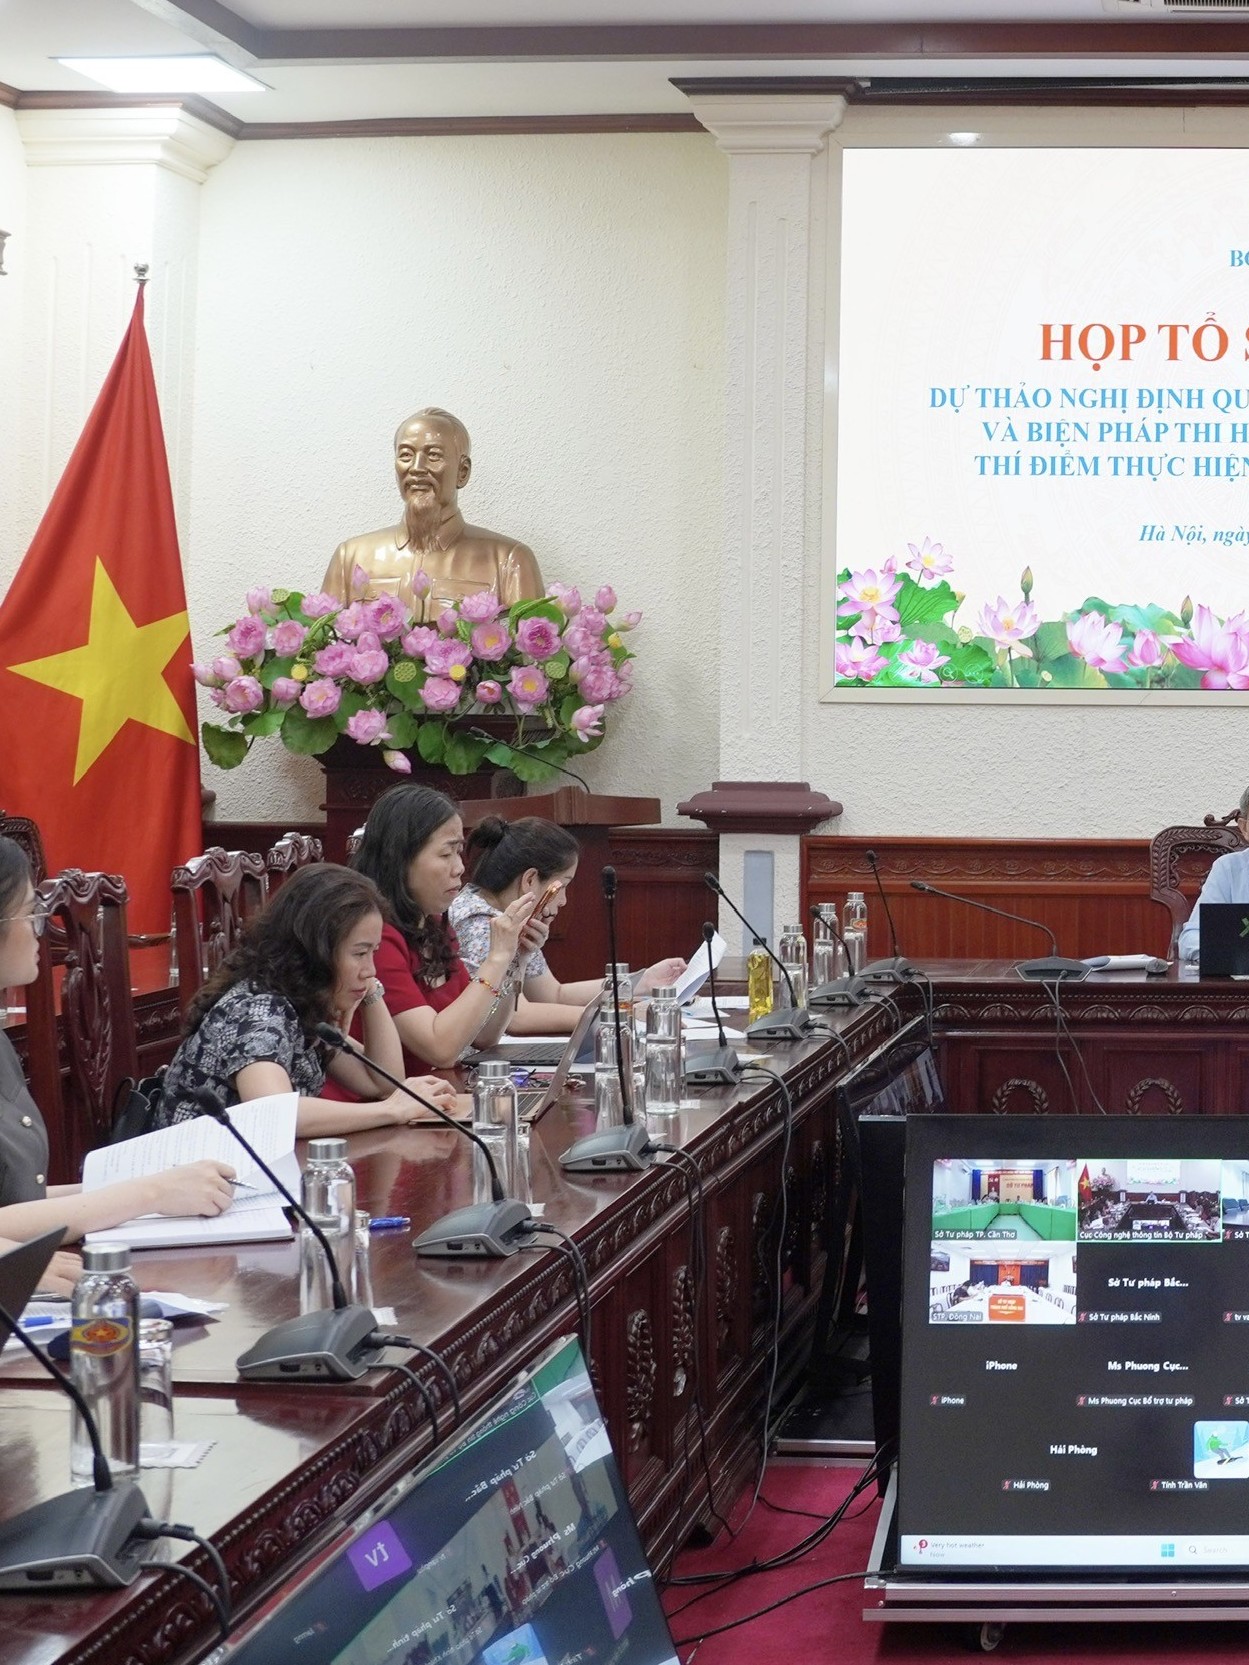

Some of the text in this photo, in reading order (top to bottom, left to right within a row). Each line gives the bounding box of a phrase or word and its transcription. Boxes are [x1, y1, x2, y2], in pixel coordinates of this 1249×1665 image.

[1039, 323, 1147, 372] HỌP
[1157, 311, 1230, 362] TỔ
[929, 384, 970, 413] DỰ
[975, 382, 1053, 409] THẢO
[1059, 388, 1130, 414] NGHỊ
[1136, 388, 1205, 414] ĐỊNH
[981, 417, 1019, 443] VÀ
[1027, 419, 1090, 448] BIỆN
[1098, 417, 1170, 443] PHÁP
[1174, 422, 1221, 443] THI
[974, 451, 1021, 476] THÍ
[1029, 449, 1100, 477] ĐIỂM
[1107, 454, 1186, 482] THỰC
[1138, 525, 1165, 542] Hà
[1171, 525, 1207, 545] Nội,
[946, 1230, 954, 1238] Tư
[956, 1230, 973, 1239] pháp
[1108, 1278, 1120, 1287] Sở
[1122, 1278, 1136, 1287] Tư
[1138, 1278, 1161, 1288] pháp
[986, 1361, 1018, 1370] iPhone
[1108, 1361, 1122, 1370] Ms
[1125, 1361, 1160, 1372] Phuong
[941, 1396, 964, 1404] iPhone
[1101, 1397, 1127, 1406] Phuong
[1175, 1397, 1193, 1406] pháp
[1050, 1444, 1098, 1456] Hải Phòng
[1013, 1481, 1049, 1491] Hải Phòng
